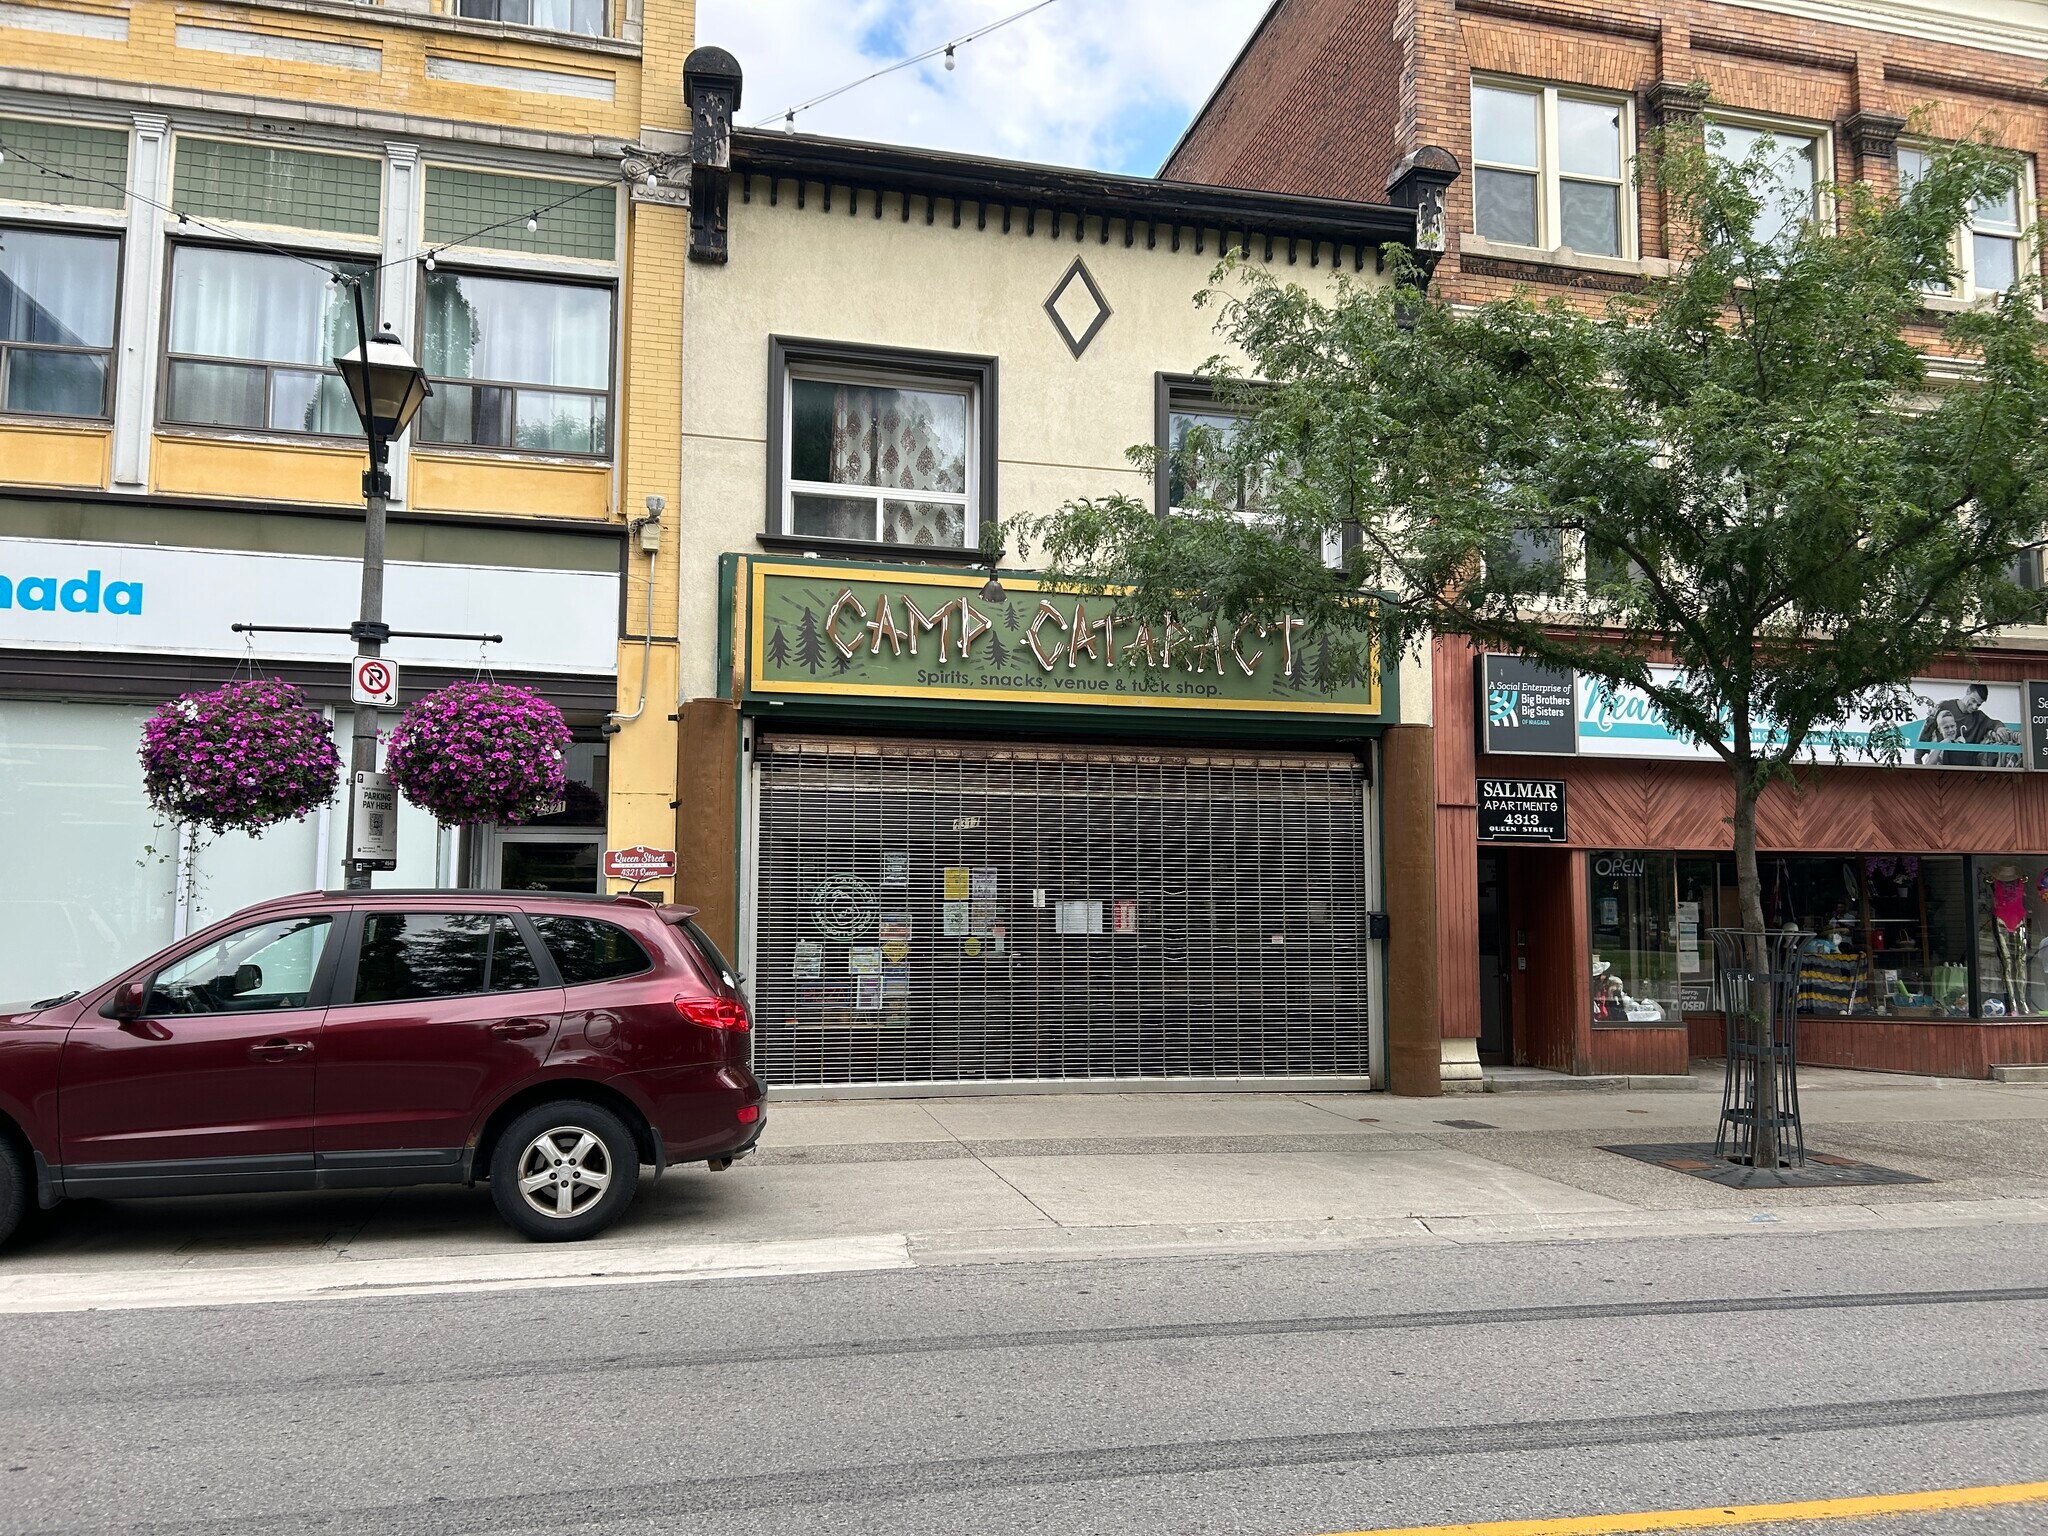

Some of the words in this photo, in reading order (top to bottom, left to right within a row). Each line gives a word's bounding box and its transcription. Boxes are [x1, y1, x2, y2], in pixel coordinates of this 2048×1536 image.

[825, 588, 992, 664] CAMP
[1019, 600, 1305, 677] CATARACT
[917, 669, 974, 686] Spirits,
[980, 673, 1048, 689] snacks,
[1054, 678, 1109, 690] venue
[1115, 678, 1126, 691] &
[1132, 679, 1171, 693] tuck
[1176, 681, 1222, 697] shop.
[1488, 681, 1496, 690] A
[1496, 681, 1521, 691] Social
[1521, 682, 1562, 694] Enterprise
[1562, 684, 1573, 694] of
[1521, 693, 1536, 707] Big
[1535, 694, 1571, 706] Brothers
[1521, 705, 1536, 719] Big
[1536, 706, 1565, 717] Sisters
[363, 791, 392, 801] PARKING
[1483, 781, 1558, 799] SALMAR
[362, 800, 375, 809] PAY
[375, 802, 393, 810] HERE
[1484, 800, 1558, 812] APARTMENTS
[1503, 813, 1540, 826] 4313
[614, 852, 640, 863] Queen
[641, 852, 666, 863] Street
[620, 868, 639, 876] 4321
[639, 868, 659, 876] Queen
[1595, 858, 1645, 876] OPEN
